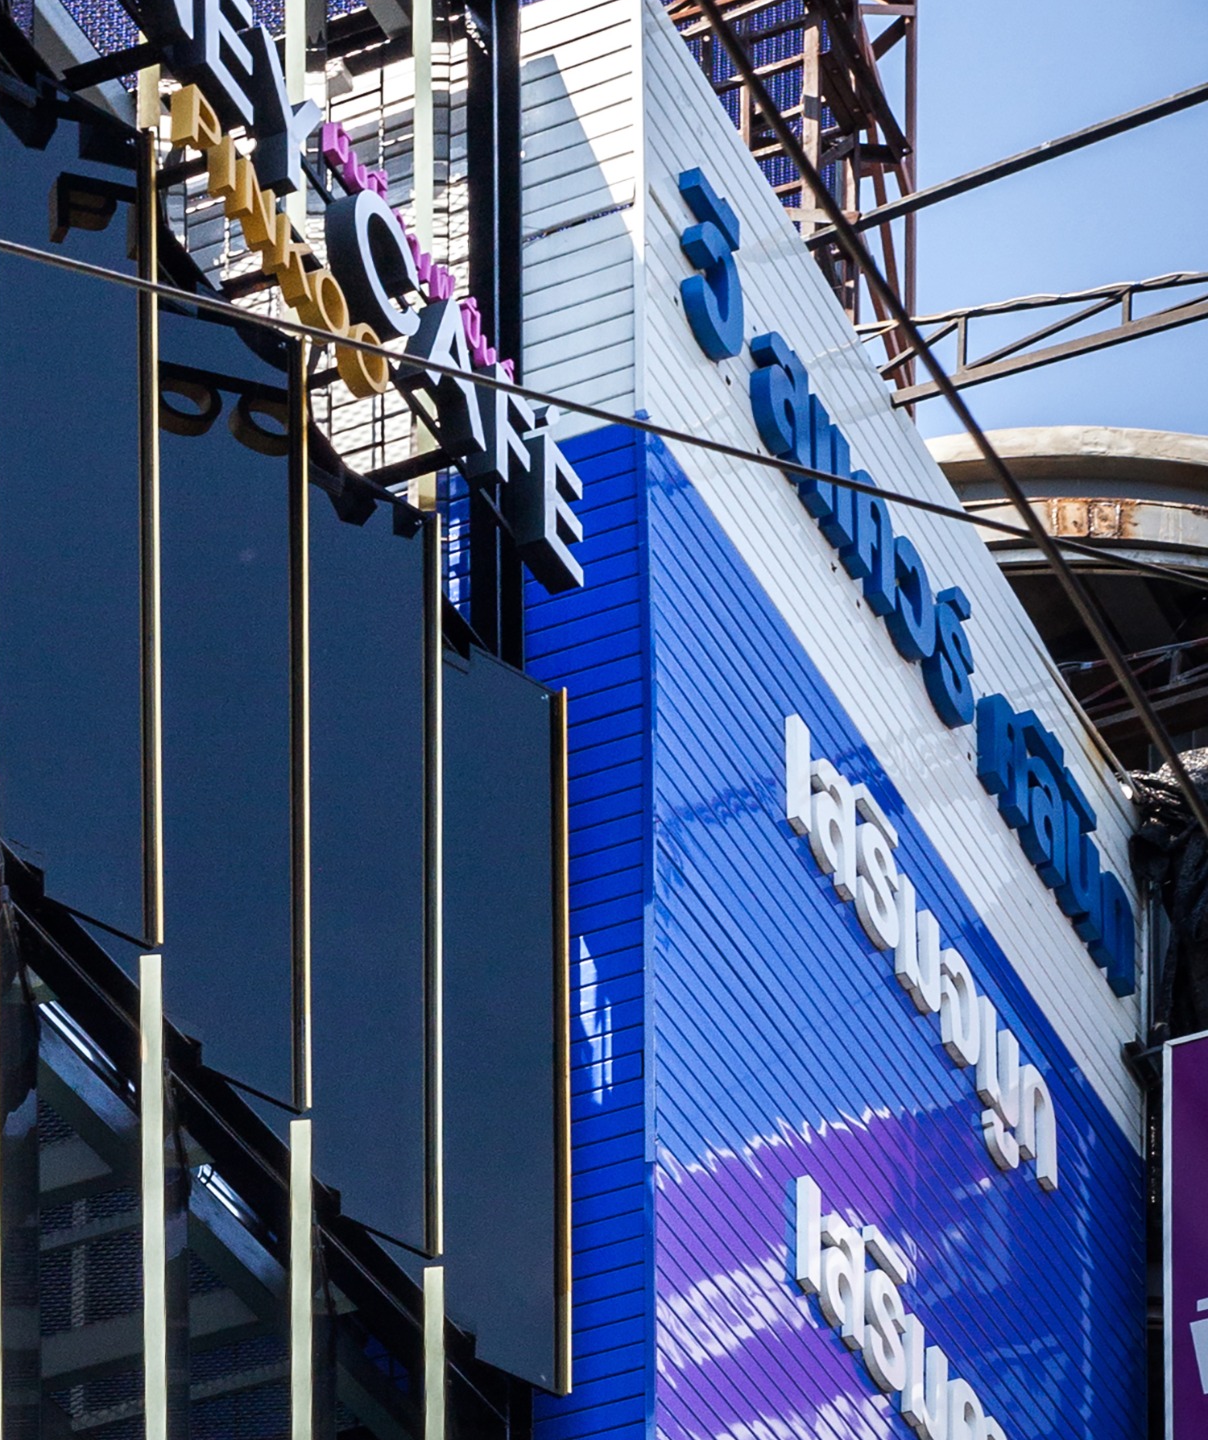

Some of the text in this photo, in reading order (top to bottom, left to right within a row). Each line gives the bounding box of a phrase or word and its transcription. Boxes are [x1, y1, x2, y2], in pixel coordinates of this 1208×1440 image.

[750, 330, 974, 728] สแควร์
[976, 691, 1135, 997] คลินิก
[785, 714, 1059, 1192] เสริมจมูก
